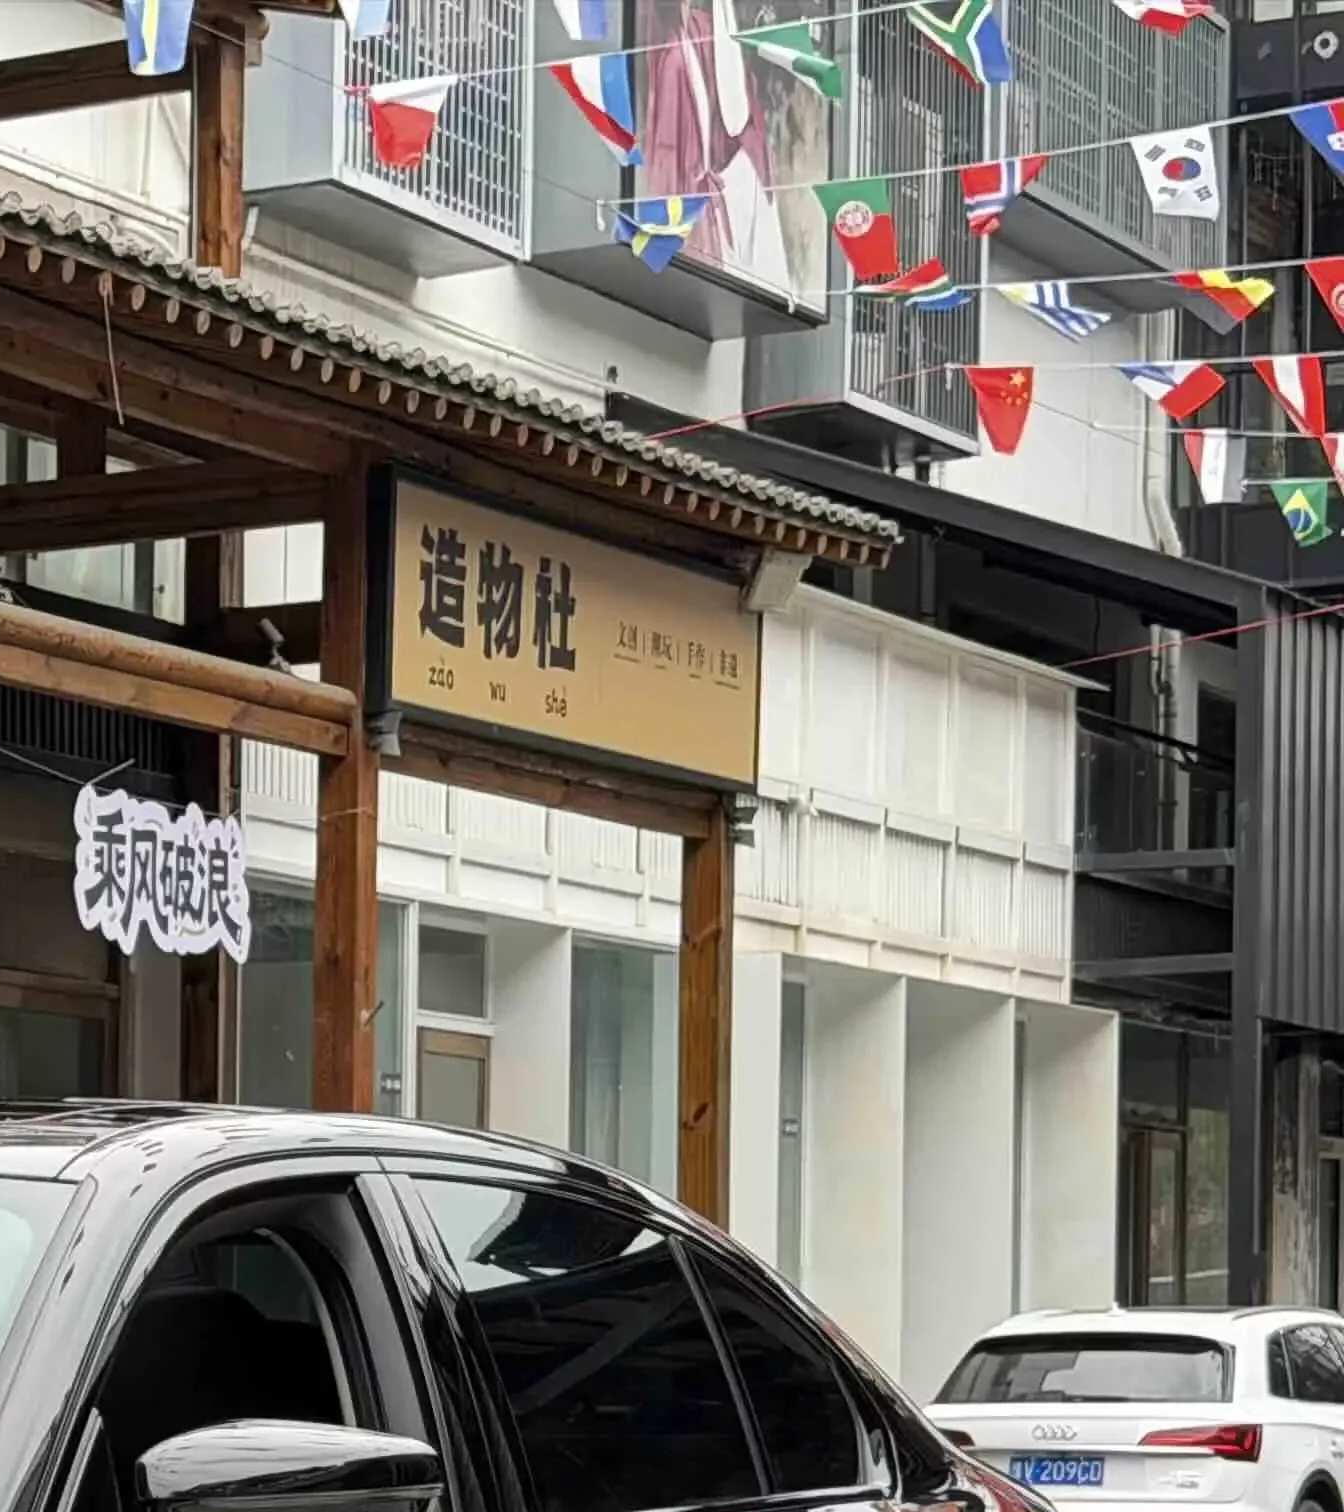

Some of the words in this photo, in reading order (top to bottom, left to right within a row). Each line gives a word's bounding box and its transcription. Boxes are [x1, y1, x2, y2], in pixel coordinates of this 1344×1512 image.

[418, 524, 577, 672] 造物社
[83, 807, 244, 946] 乘风破浪
